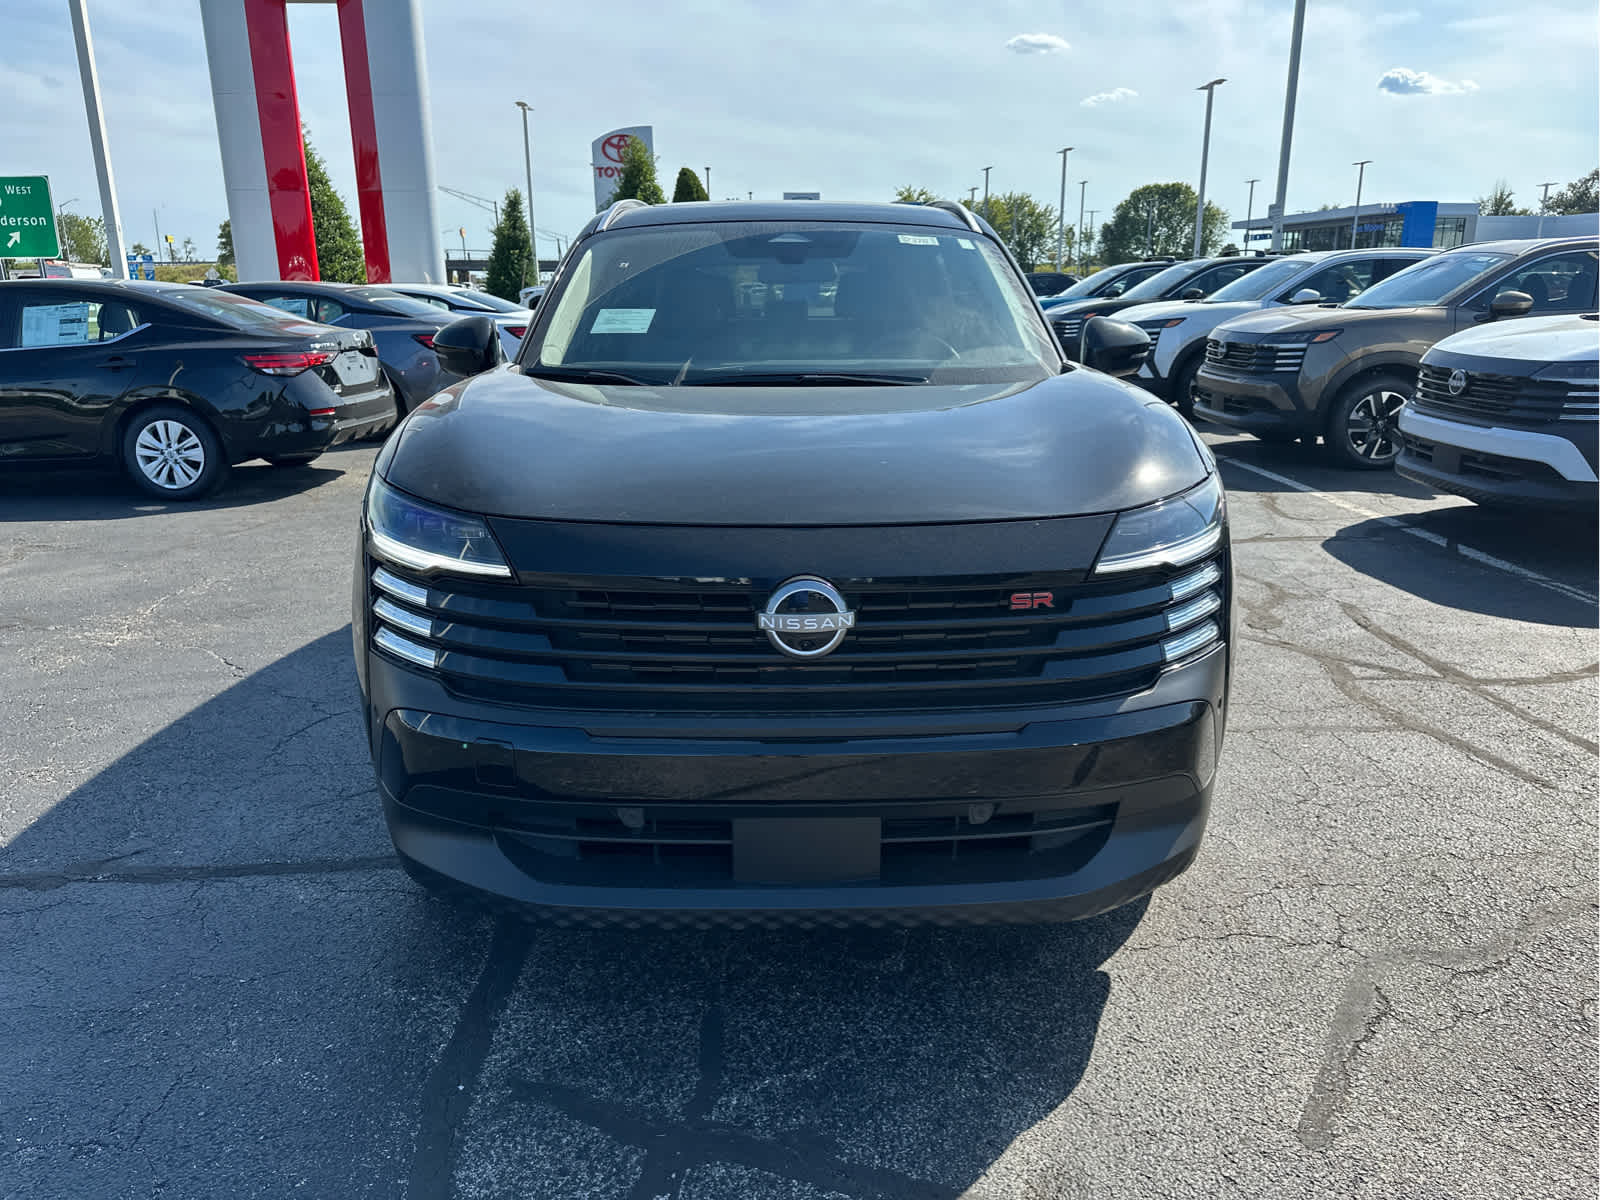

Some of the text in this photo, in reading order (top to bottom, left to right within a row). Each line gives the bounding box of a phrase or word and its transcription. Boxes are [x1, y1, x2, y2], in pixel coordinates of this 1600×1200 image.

[596, 166, 623, 178] TOY
[5, 185, 31, 194] WEST
[0, 216, 46, 226] derson
[1011, 592, 1054, 609] SR
[761, 615, 852, 629] NISSAN
